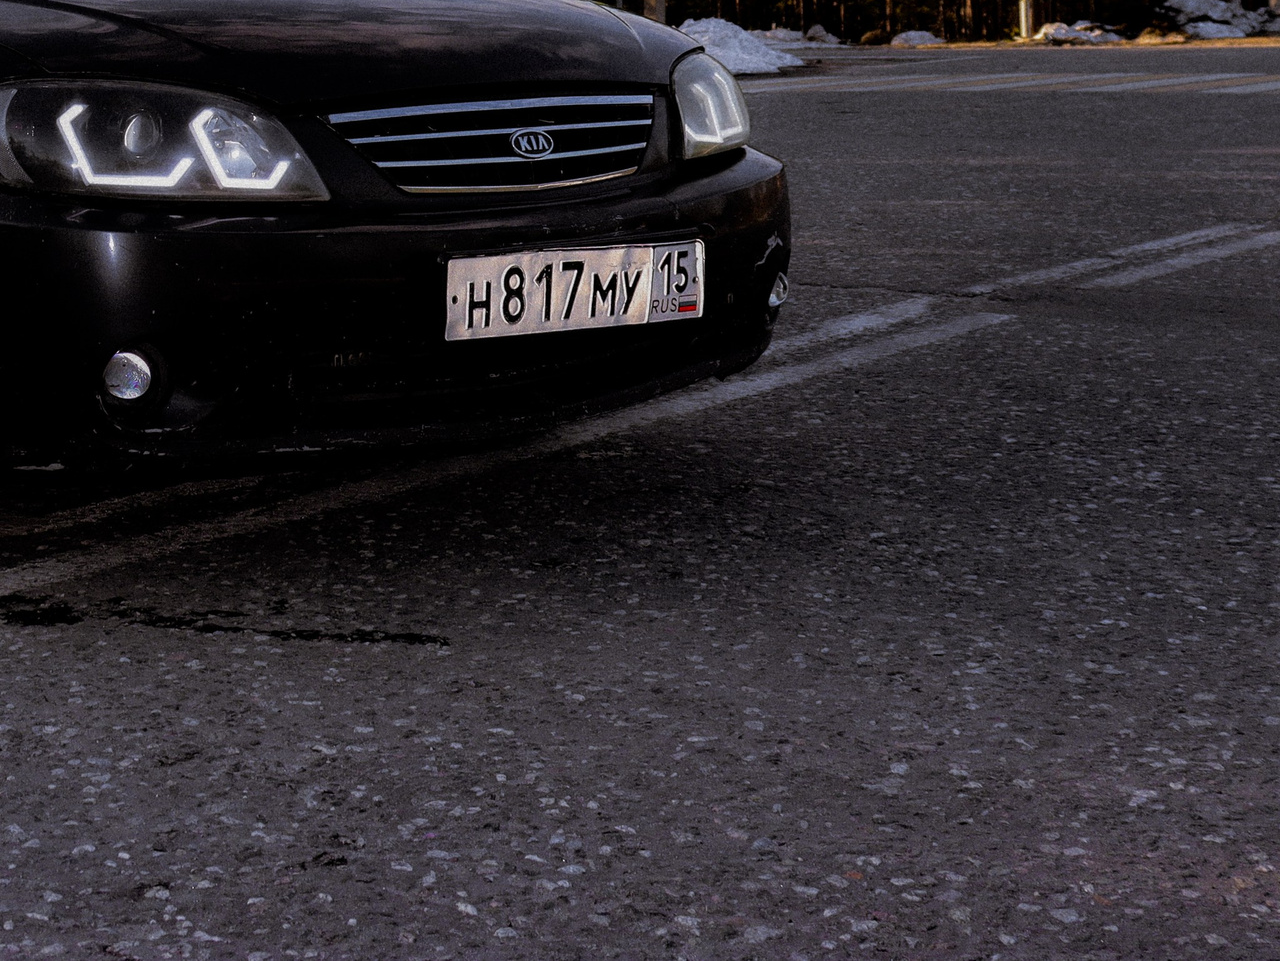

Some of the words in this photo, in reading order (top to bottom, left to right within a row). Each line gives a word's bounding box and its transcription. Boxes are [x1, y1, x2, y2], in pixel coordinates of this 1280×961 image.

[517, 135, 549, 151] KIA
[658, 250, 688, 295] 15
[651, 298, 678, 314] RUS
